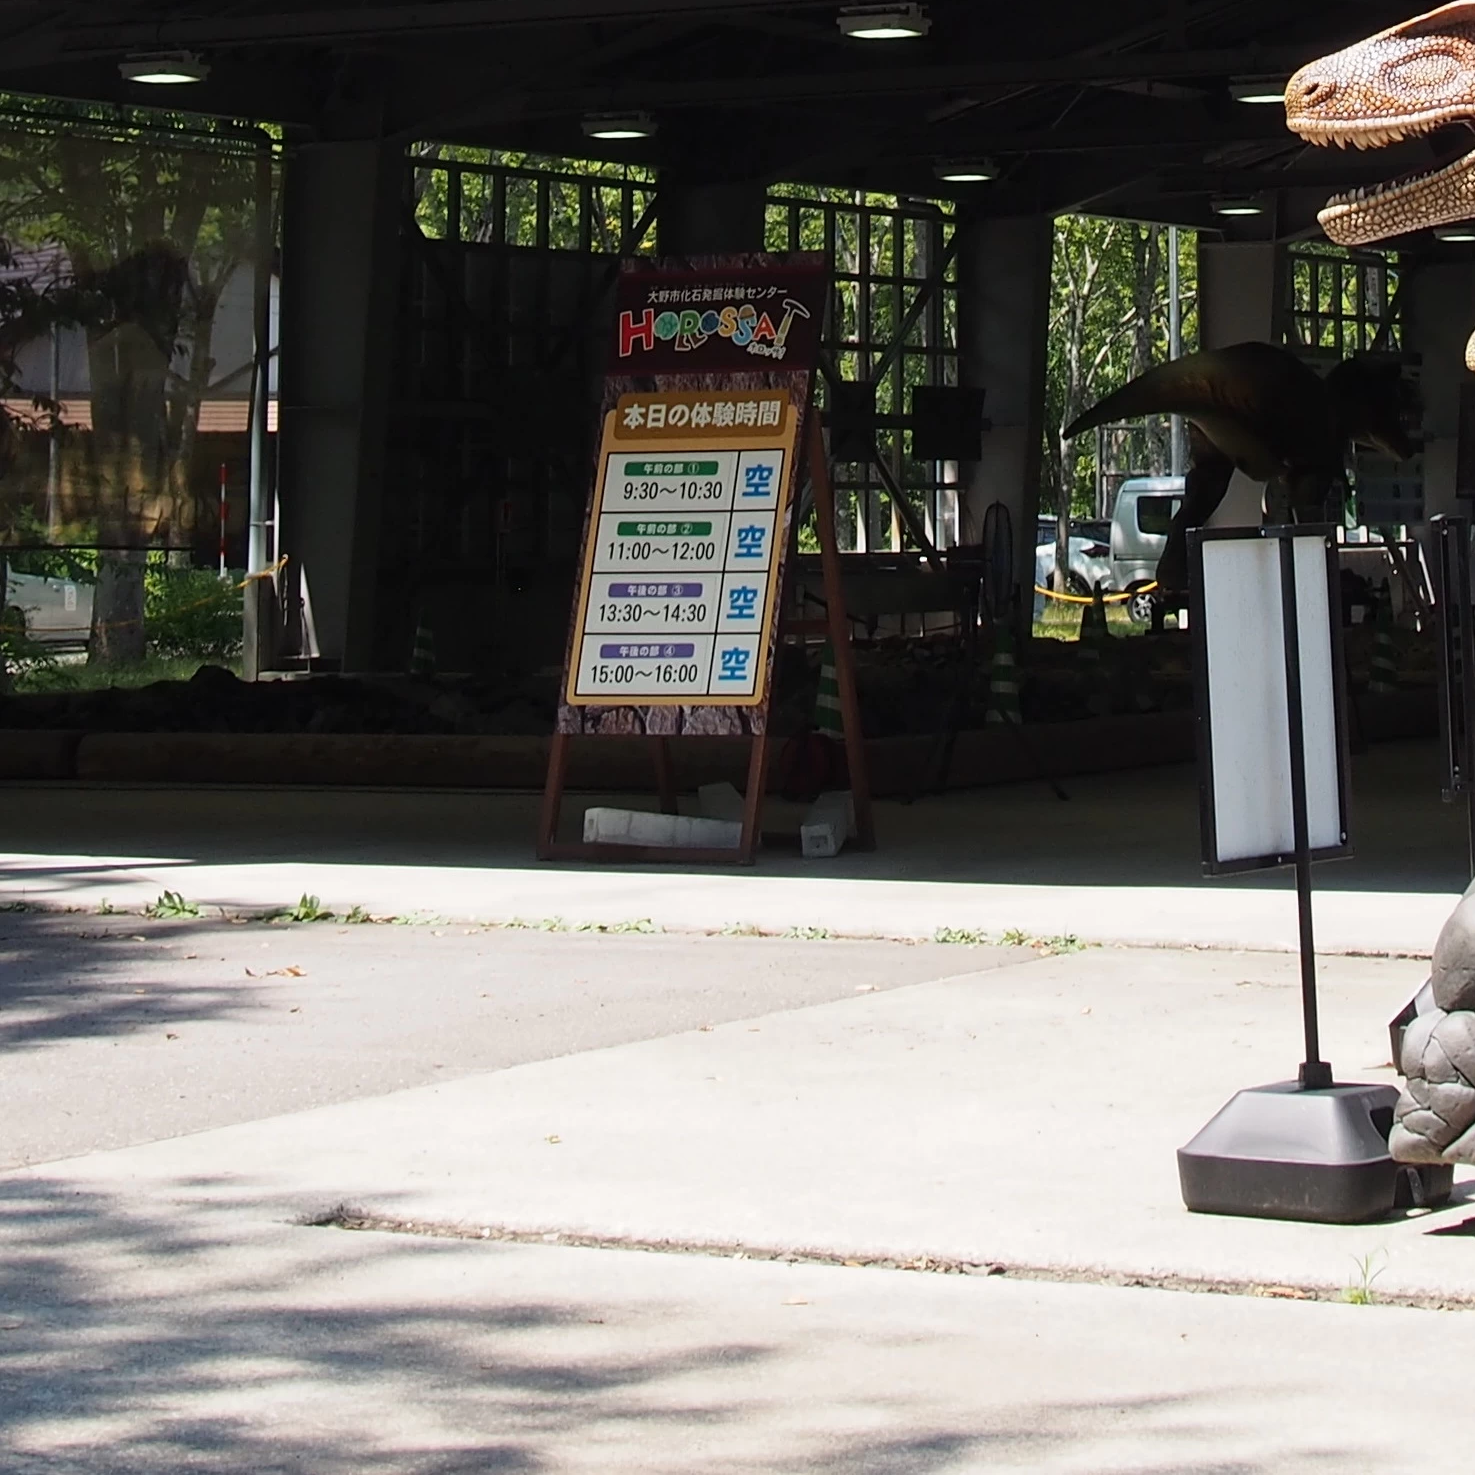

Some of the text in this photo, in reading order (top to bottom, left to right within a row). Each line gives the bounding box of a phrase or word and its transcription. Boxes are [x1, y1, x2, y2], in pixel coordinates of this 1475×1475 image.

[646, 285, 788, 304] 大野市化石発掘体験センター
[622, 400, 782, 429] 本日の体験時間
[741, 463, 774, 498] 空
[734, 524, 766, 559] 空
[726, 585, 758, 620] 空
[718, 646, 750, 681] 空
